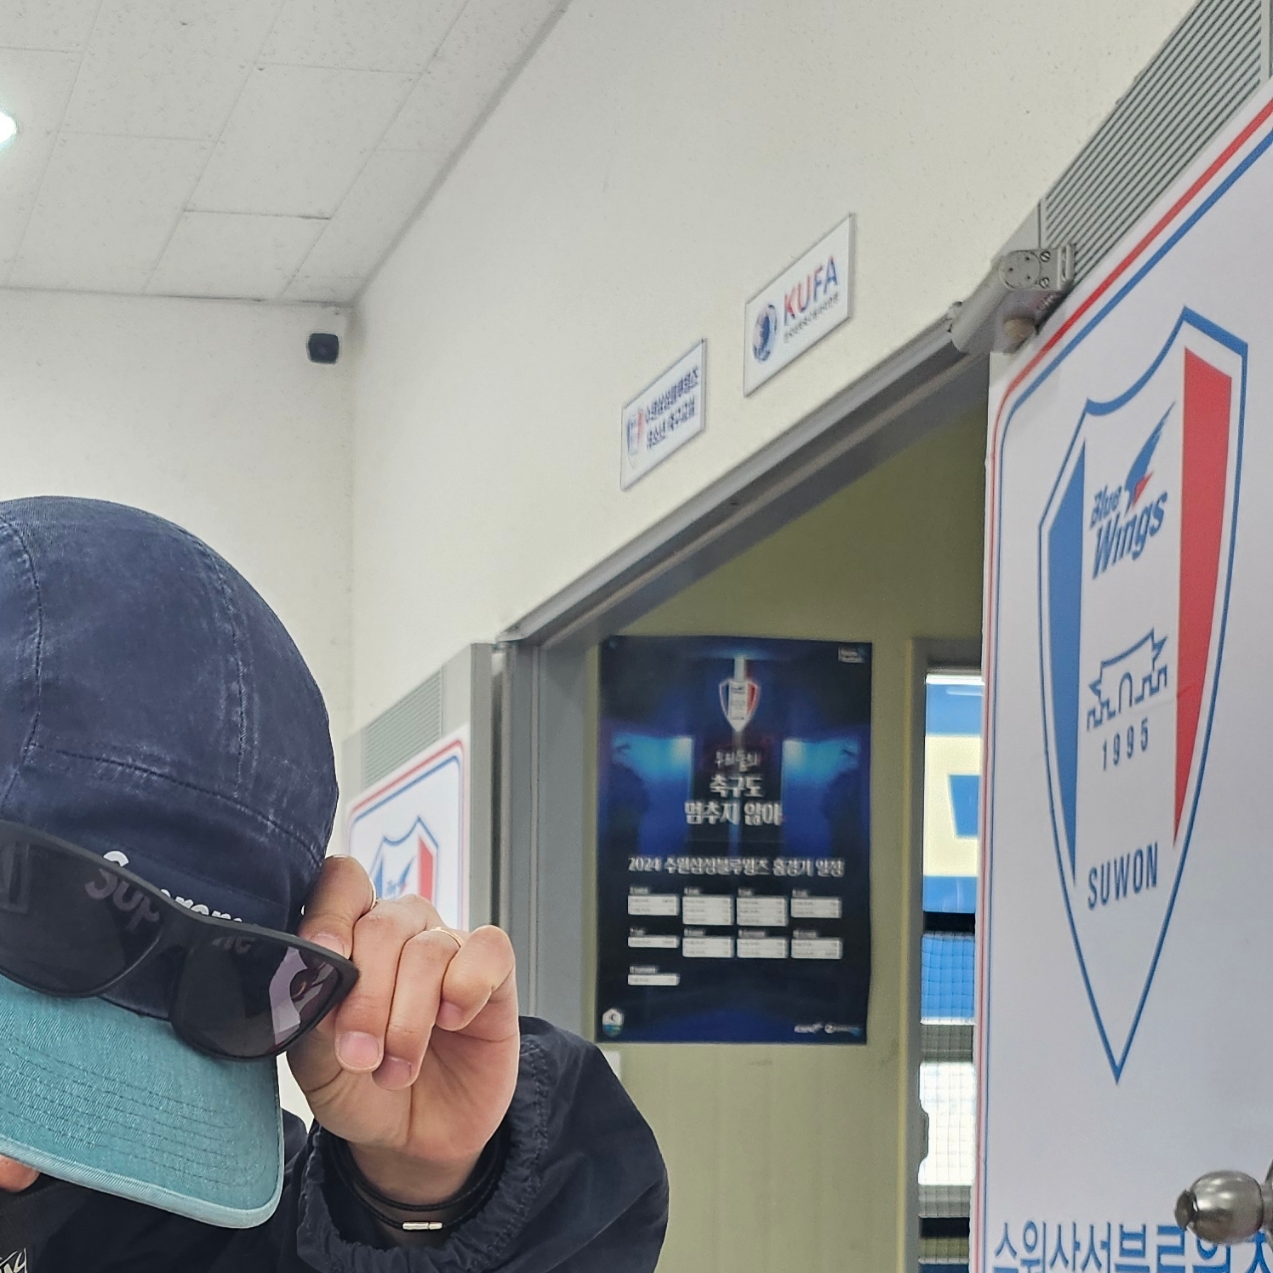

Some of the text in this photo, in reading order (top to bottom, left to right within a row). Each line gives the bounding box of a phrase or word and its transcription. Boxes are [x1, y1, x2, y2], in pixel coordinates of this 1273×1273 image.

[784, 255, 838, 326] KUFA
[1090, 485, 1123, 530] Blue
[1092, 491, 1168, 580] Wings
[1102, 716, 1150, 772] 1995
[628, 857, 662, 873] 2024
[1088, 840, 1158, 911] SUWON
